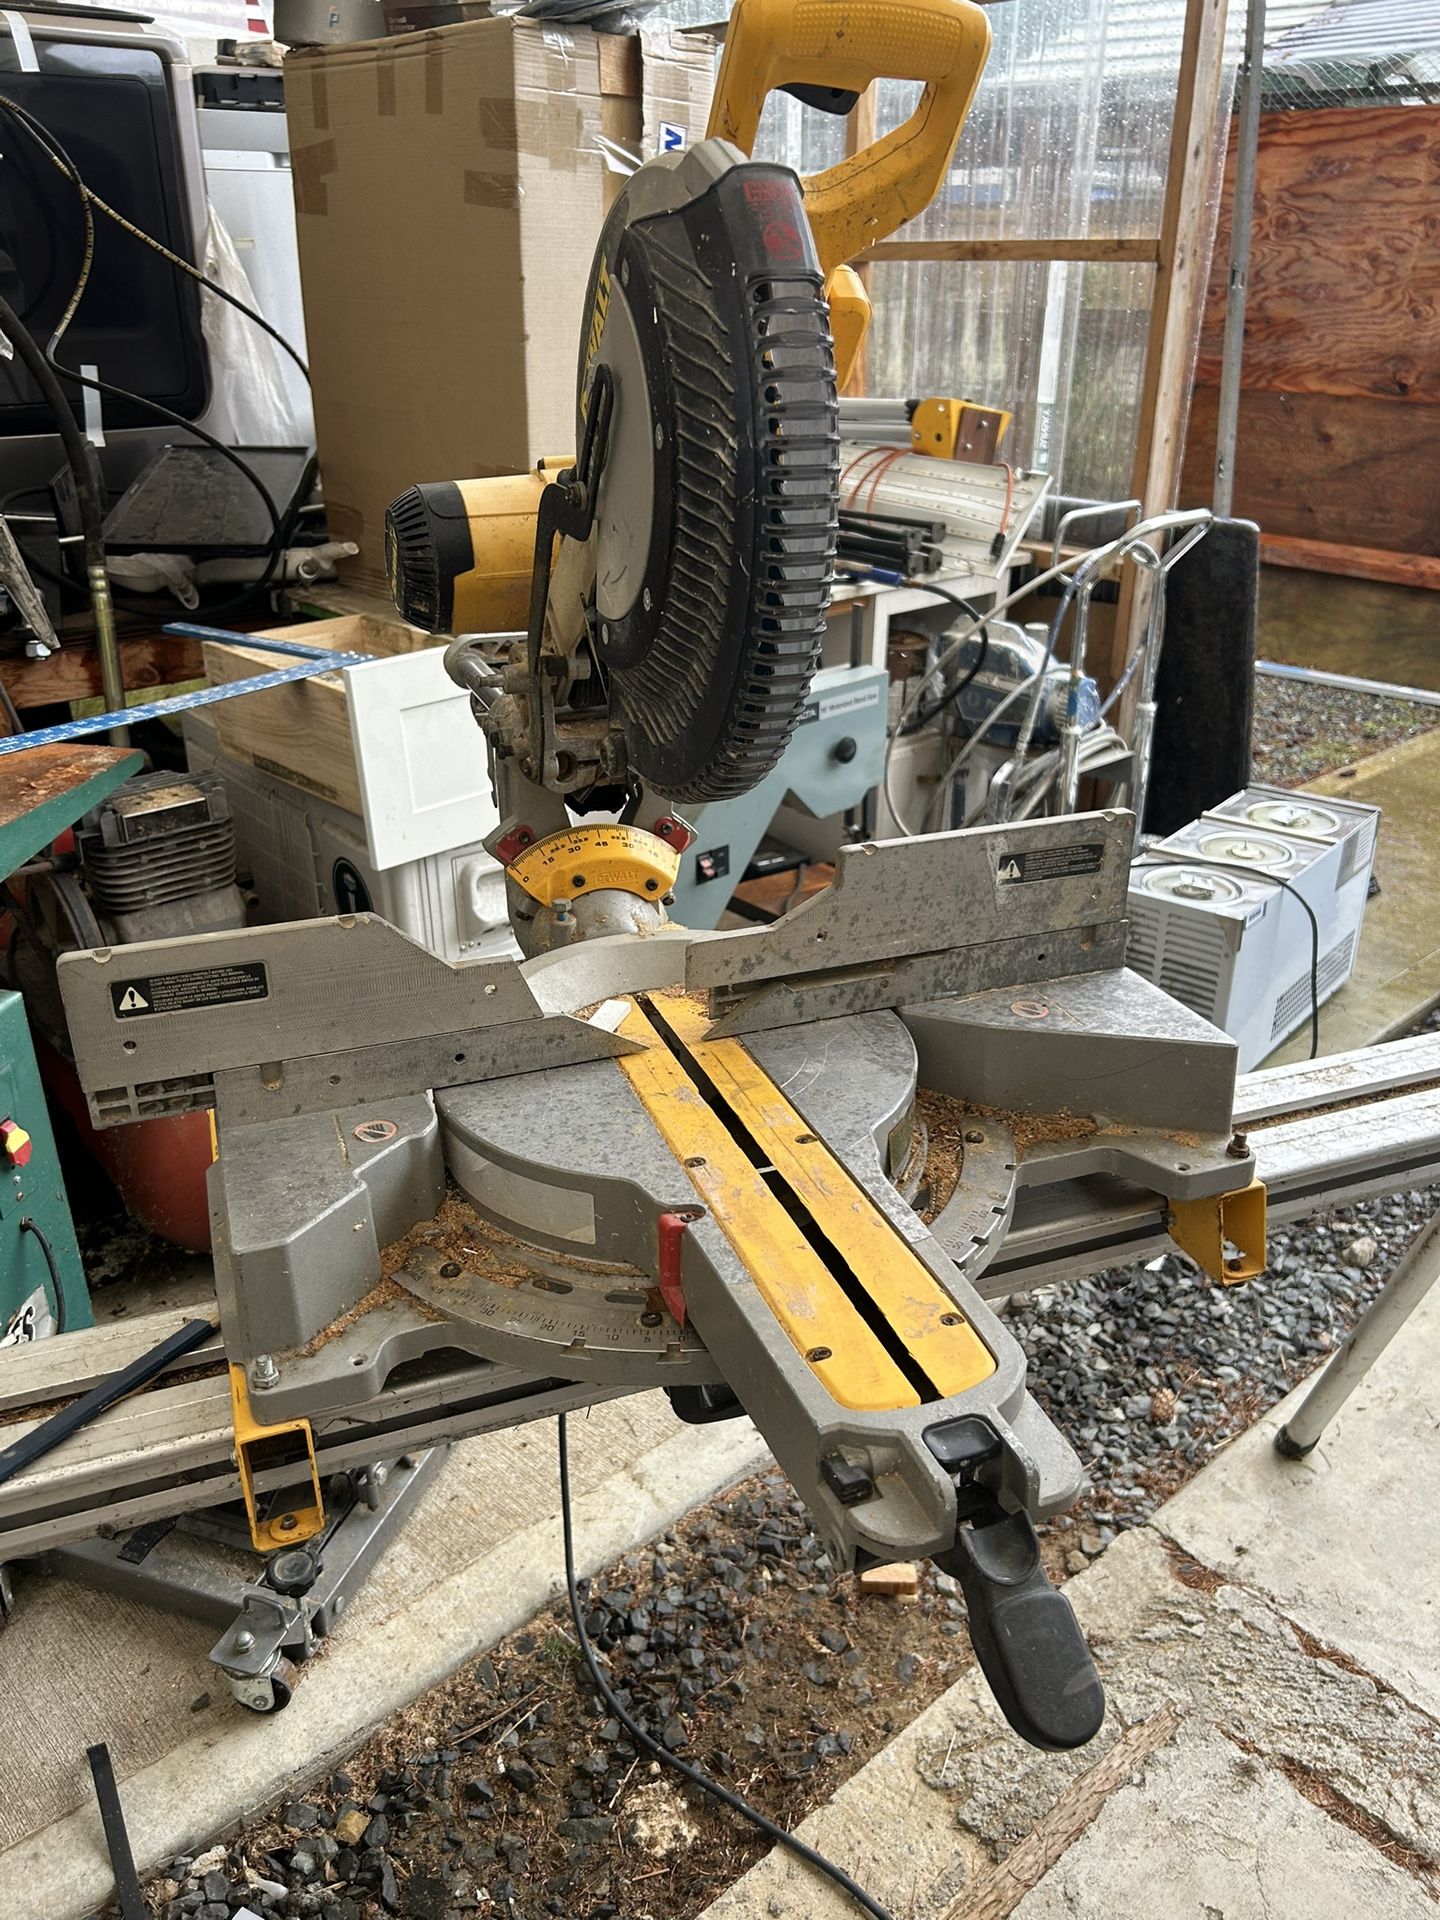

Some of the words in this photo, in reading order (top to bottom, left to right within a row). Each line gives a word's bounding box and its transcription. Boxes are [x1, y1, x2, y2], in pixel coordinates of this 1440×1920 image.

[543, 856, 555, 866] 15
[568, 845, 581, 854] 30
[480, 1308, 496, 1317] 30
[540, 1323, 555, 1332] 20
[572, 1330, 586, 1338] 15
